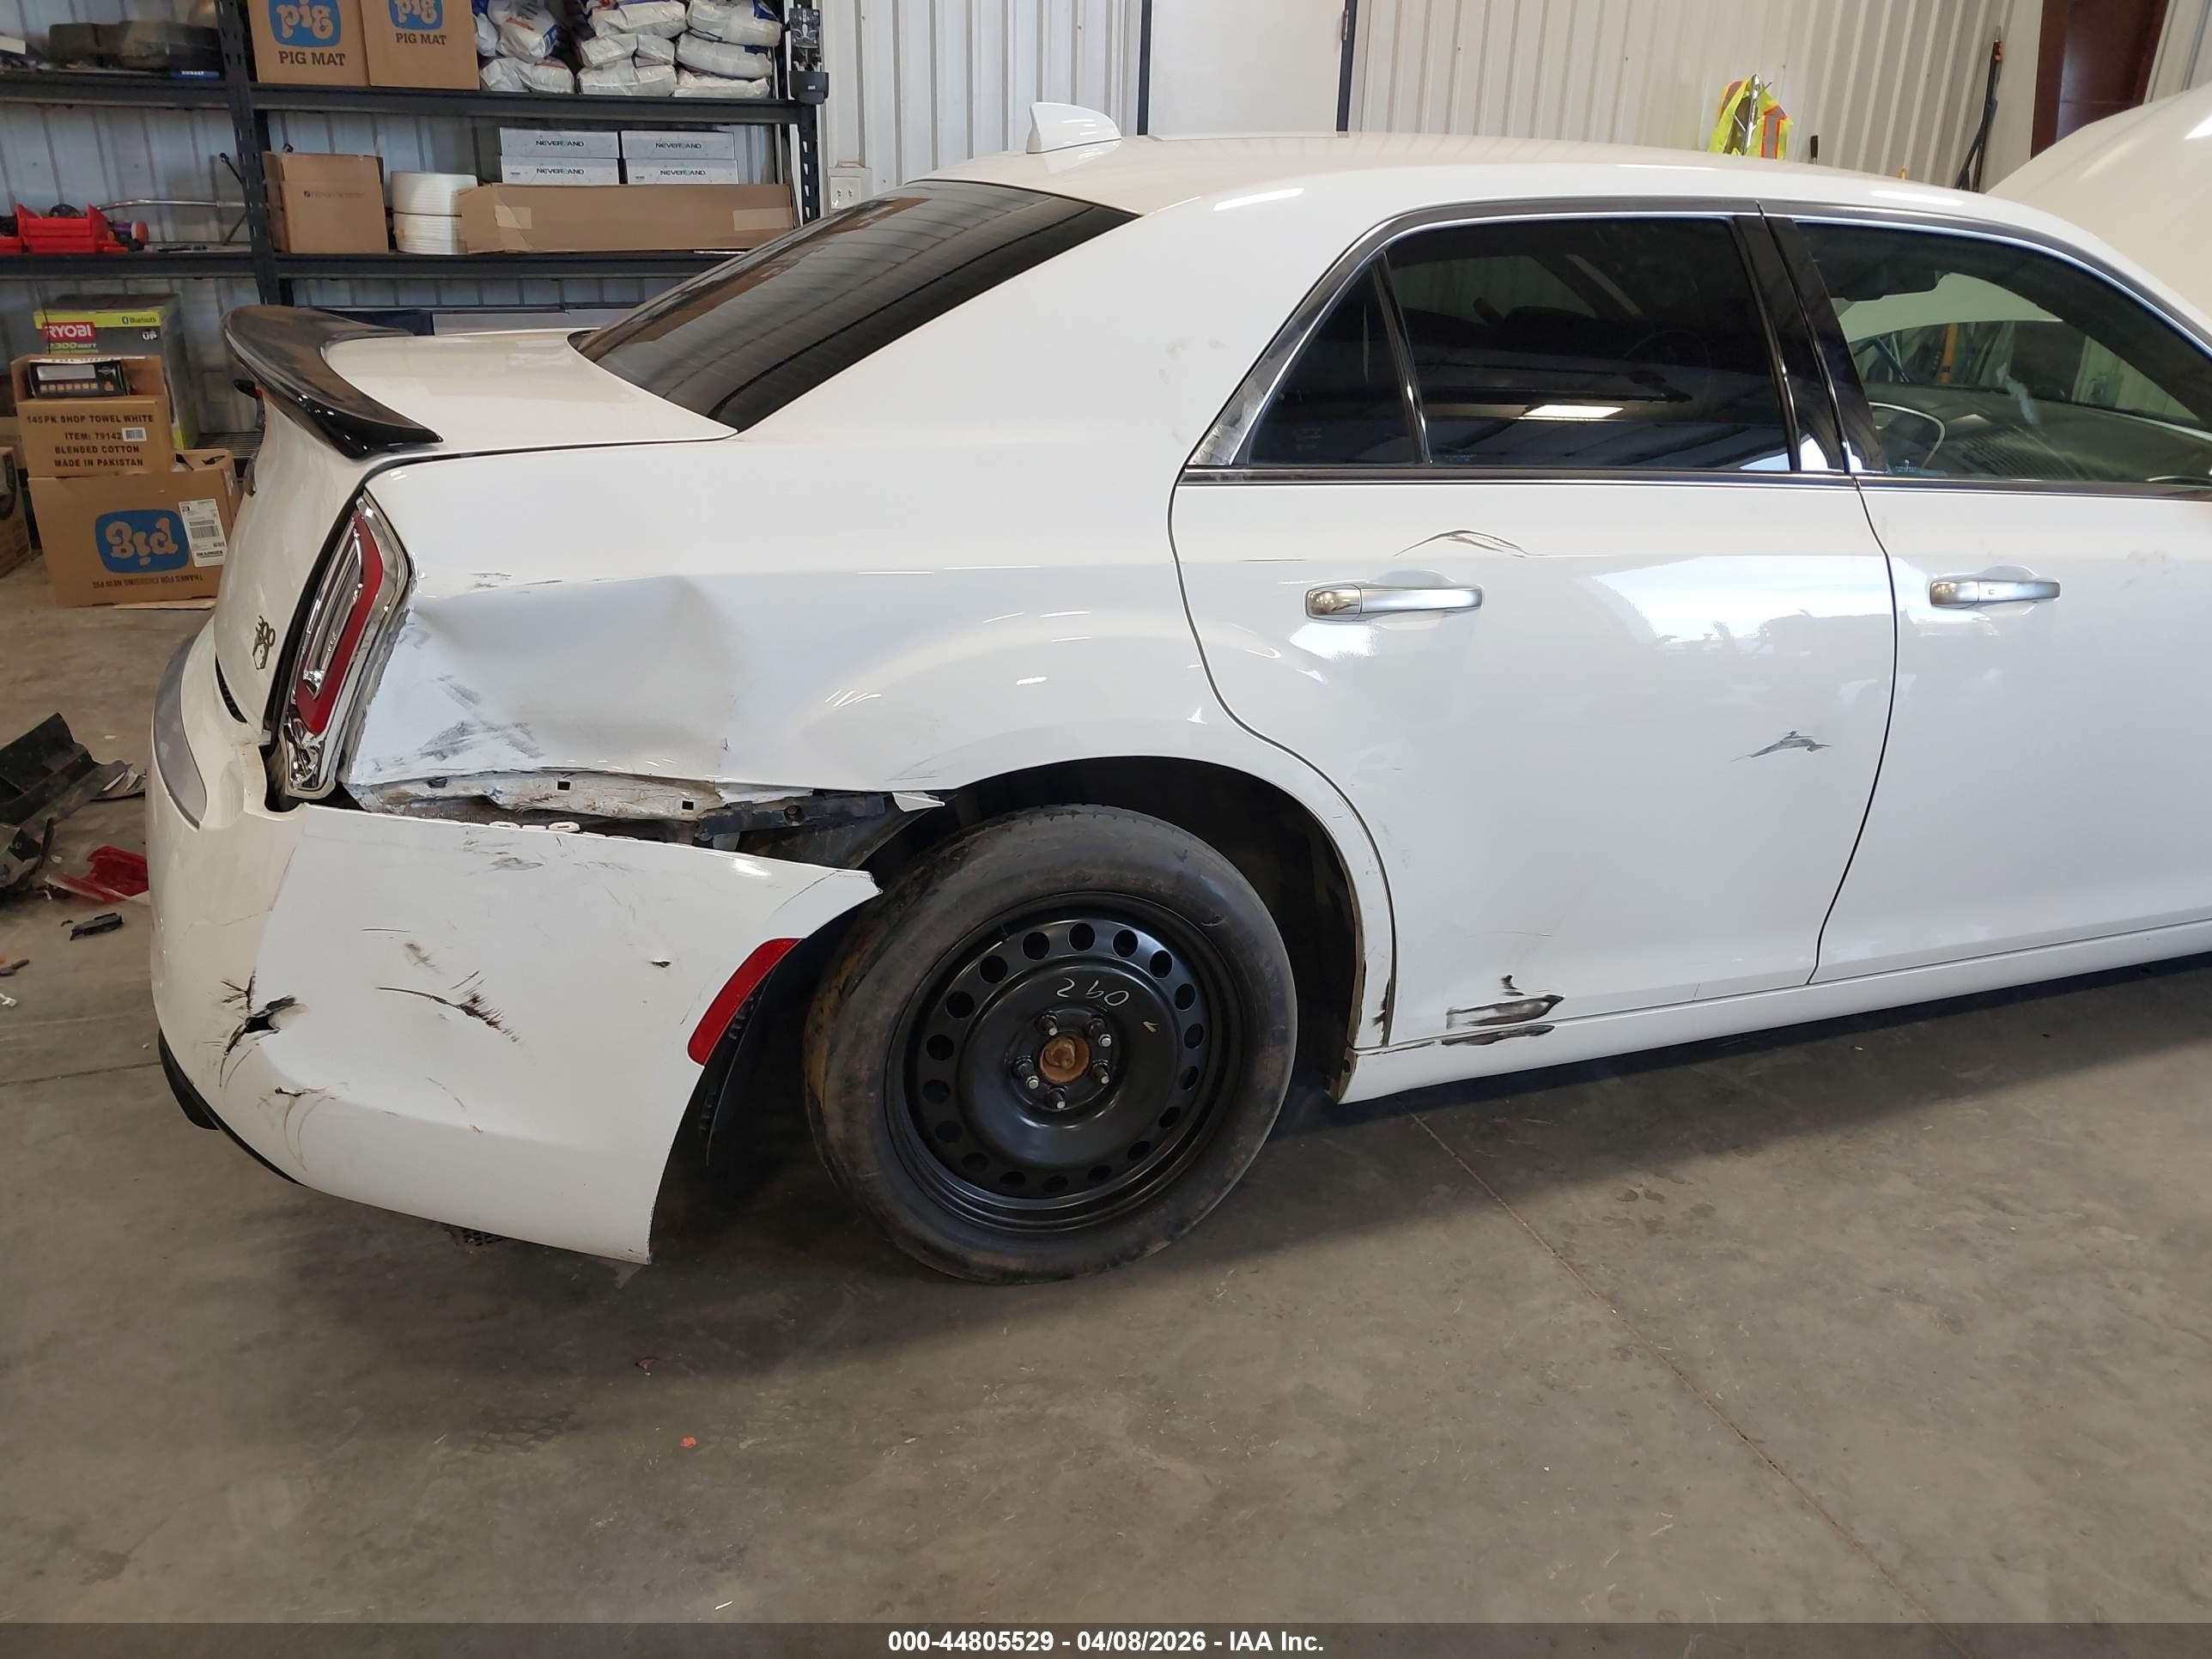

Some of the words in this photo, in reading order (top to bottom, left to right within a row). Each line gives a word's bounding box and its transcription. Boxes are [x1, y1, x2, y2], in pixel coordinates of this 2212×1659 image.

[276, 0, 334, 40] pig
[396, 33, 417, 44] PIG
[420, 34, 447, 46] MAT
[278, 51, 307, 64] PIG
[312, 52, 345, 66] MAT
[45, 325, 92, 337] RYOBI
[60, 415, 85, 423] SHOP
[89, 415, 120, 423] TOWEL
[124, 414, 154, 422] WHITE
[55, 446, 98, 454] BLENDED
